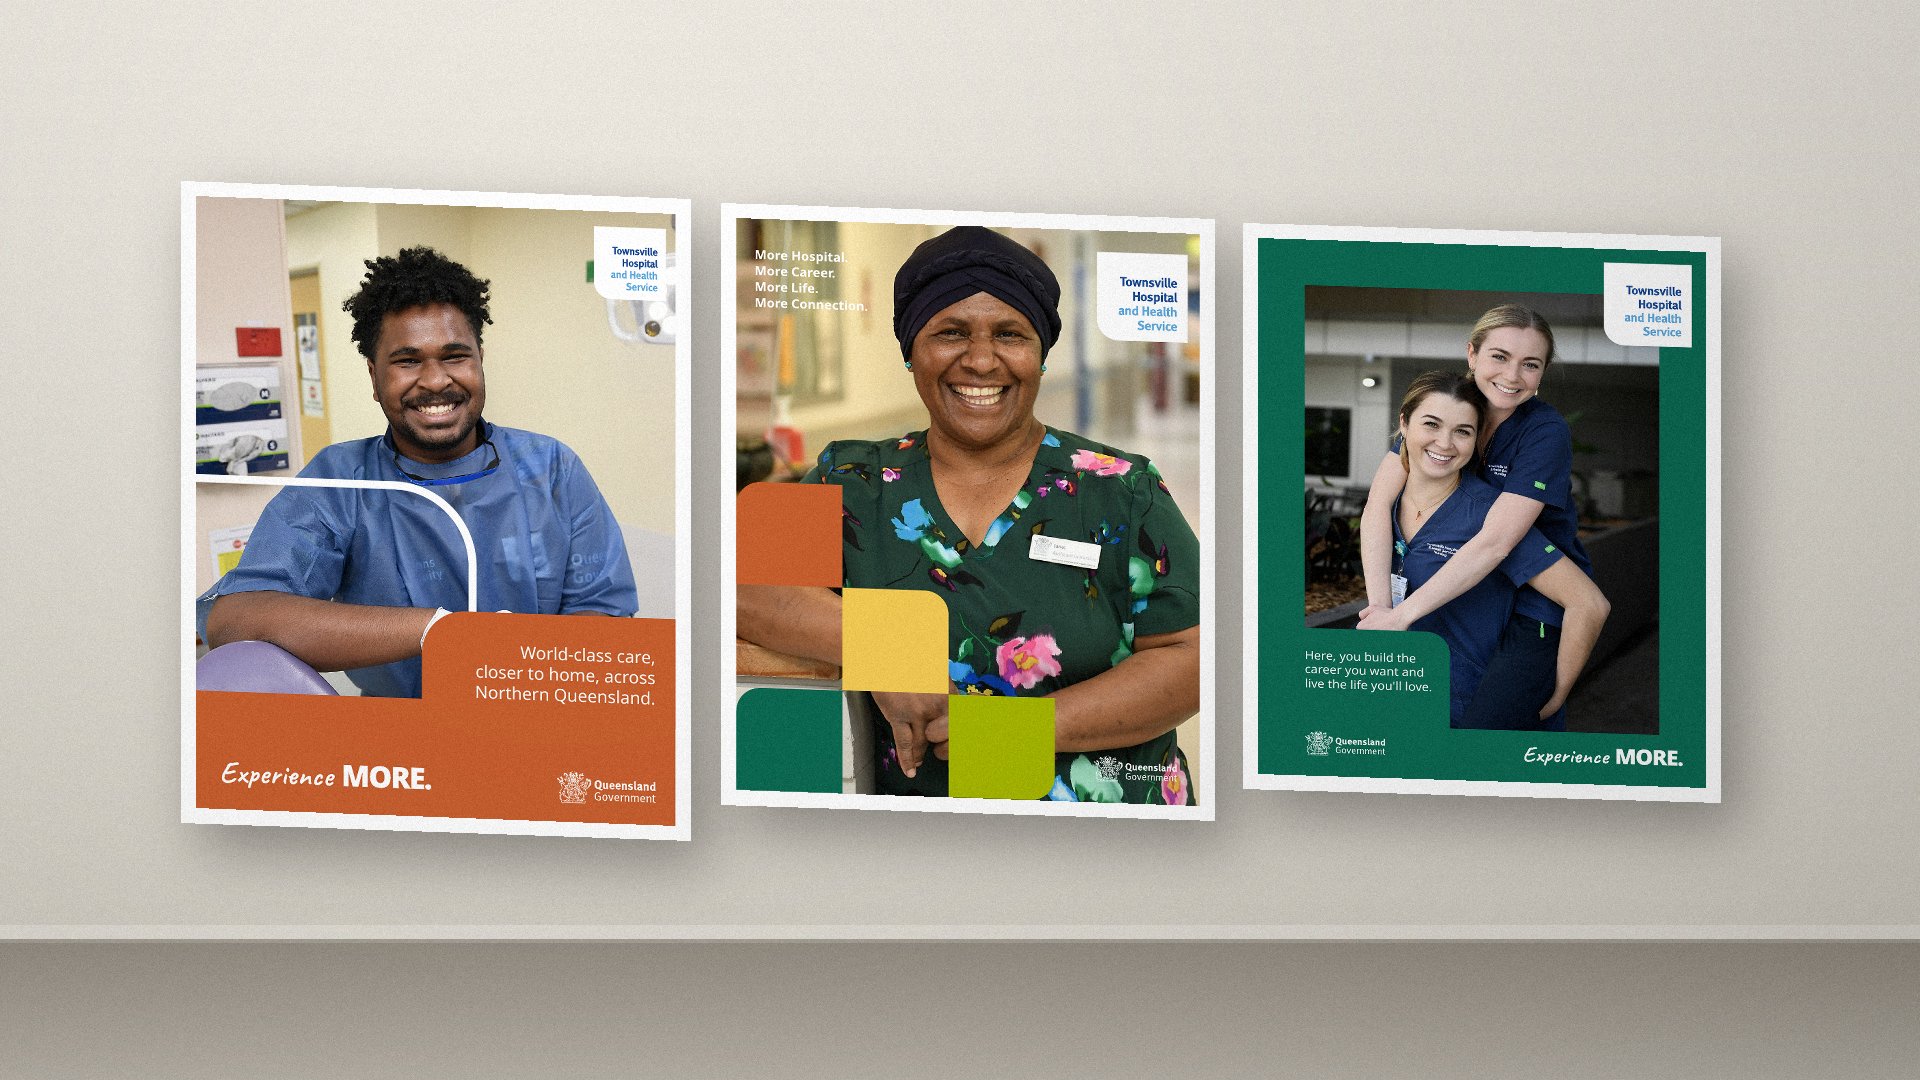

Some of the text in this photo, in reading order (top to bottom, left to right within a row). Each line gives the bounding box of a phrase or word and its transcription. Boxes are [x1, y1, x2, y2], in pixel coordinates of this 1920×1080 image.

[612, 247, 658, 256] Townsville
[755, 250, 848, 264] More Hospital.
[623, 259, 658, 269] Hospital
[611, 271, 657, 280] and Health
[755, 266, 835, 279] More Career.
[626, 283, 658, 292] Service
[755, 282, 818, 294] More Life.
[1120, 277, 1177, 288] Townsville
[1626, 286, 1682, 296] Townsville
[1133, 292, 1178, 304] Hospital
[755, 298, 868, 312] More Connection.
[1639, 300, 1682, 311] Hospital
[1119, 306, 1177, 317] and Health
[1625, 313, 1682, 323] and Health
[1138, 321, 1177, 331] Service
[1643, 327, 1682, 337] Service
[521, 646, 655, 666] World-class care,
[1305, 651, 1416, 663] Here, you build the
[476, 665, 655, 685] closer to home, across
[1305, 666, 1424, 678] career you want and
[1305, 679, 1325, 689] live
[1328, 679, 1346, 689] the
[1350, 680, 1368, 690] life
[1406, 682, 1432, 692] love.
[476, 686, 655, 706] Northern Queensland.
[1336, 738, 1386, 746] Queensland
[1336, 746, 1386, 756] Government
[1524, 747, 1683, 767] Experience MORE.
[1125, 763, 1178, 772] Queensland
[222, 762, 432, 790] Experience MORE.
[1126, 773, 1178, 782] Government
[594, 779, 657, 792] Queensland
[594, 792, 657, 804] Government
